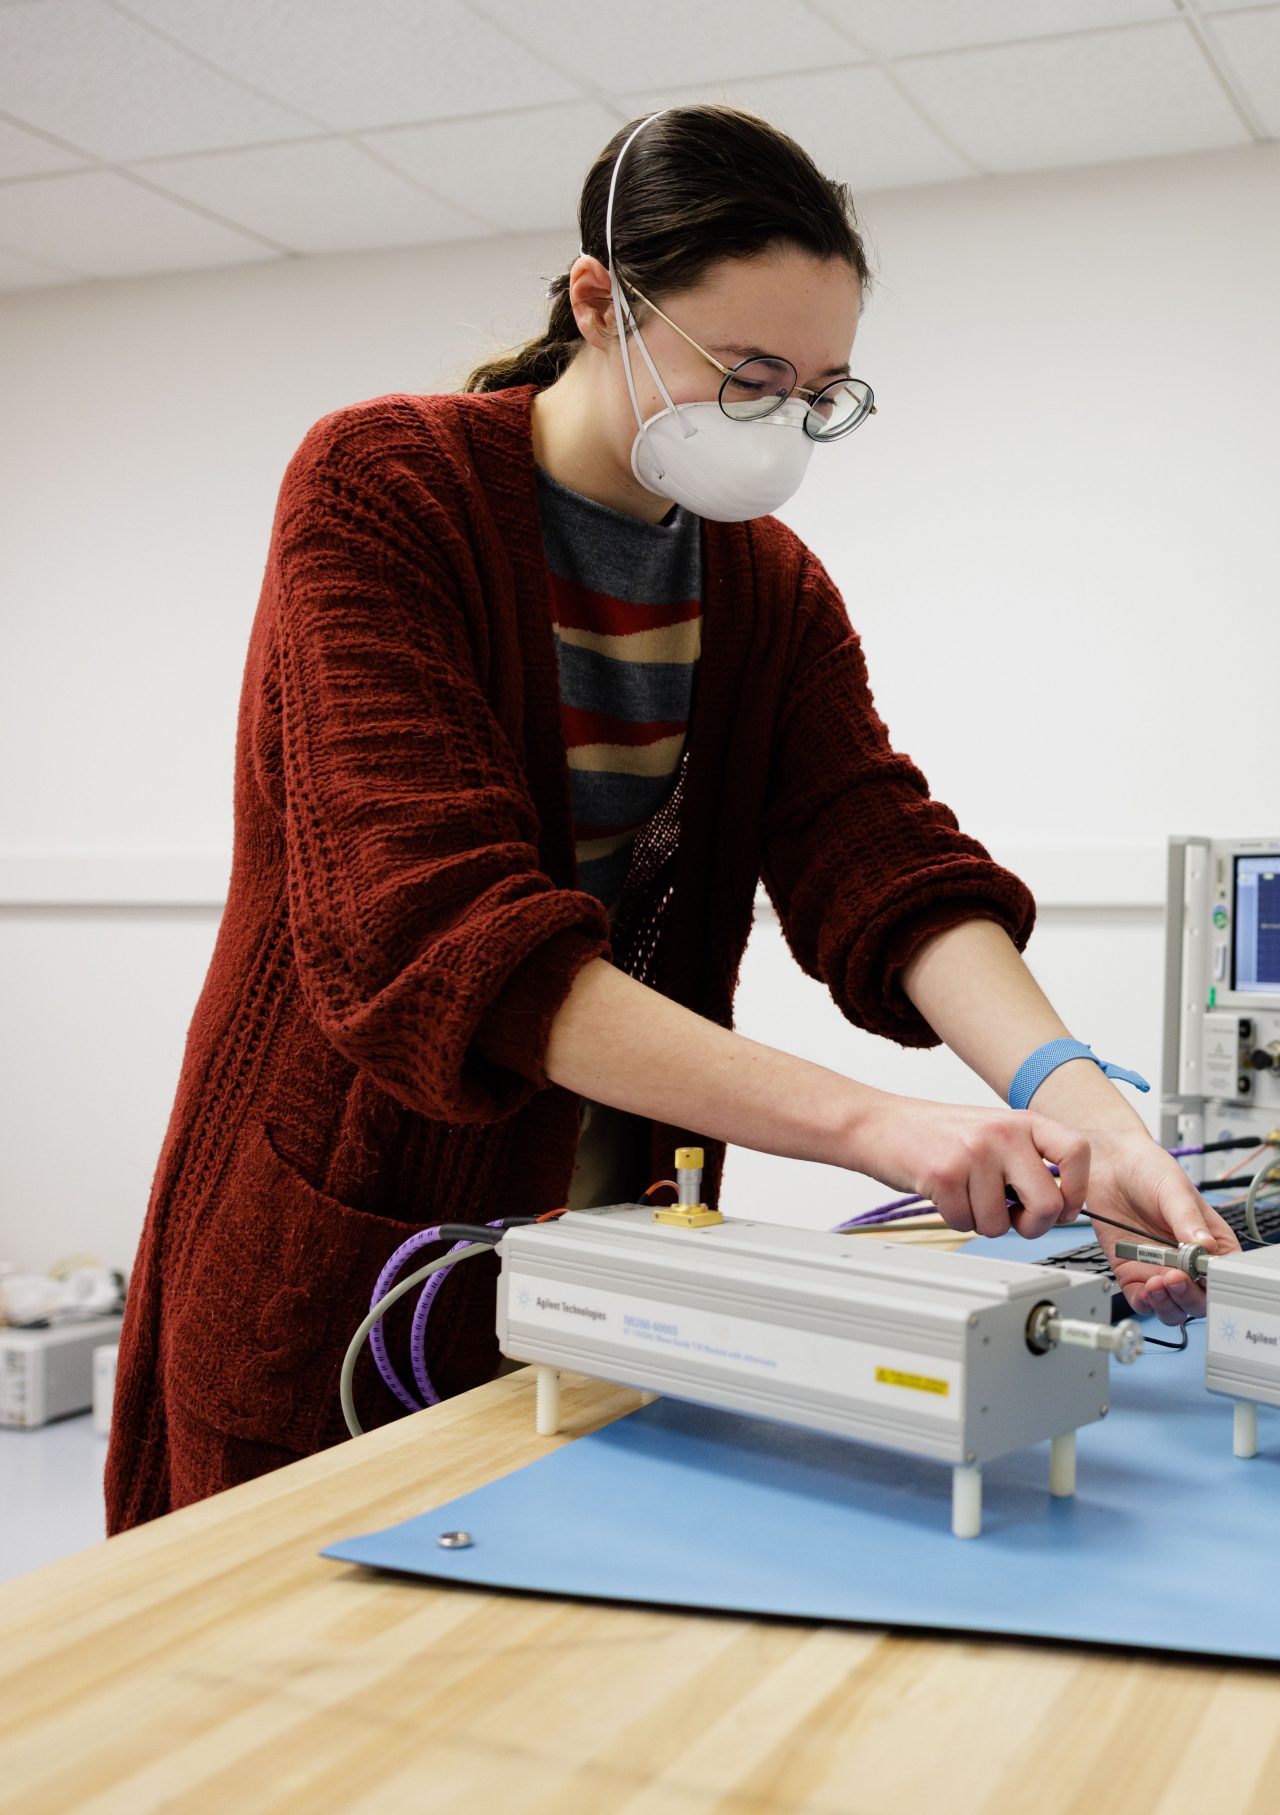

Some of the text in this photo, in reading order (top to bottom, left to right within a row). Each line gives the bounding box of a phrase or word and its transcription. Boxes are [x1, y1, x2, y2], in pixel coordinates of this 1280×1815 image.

[536, 1296, 607, 1321] Agilent Technologies
[1246, 1330, 1278, 1346] Agilent
